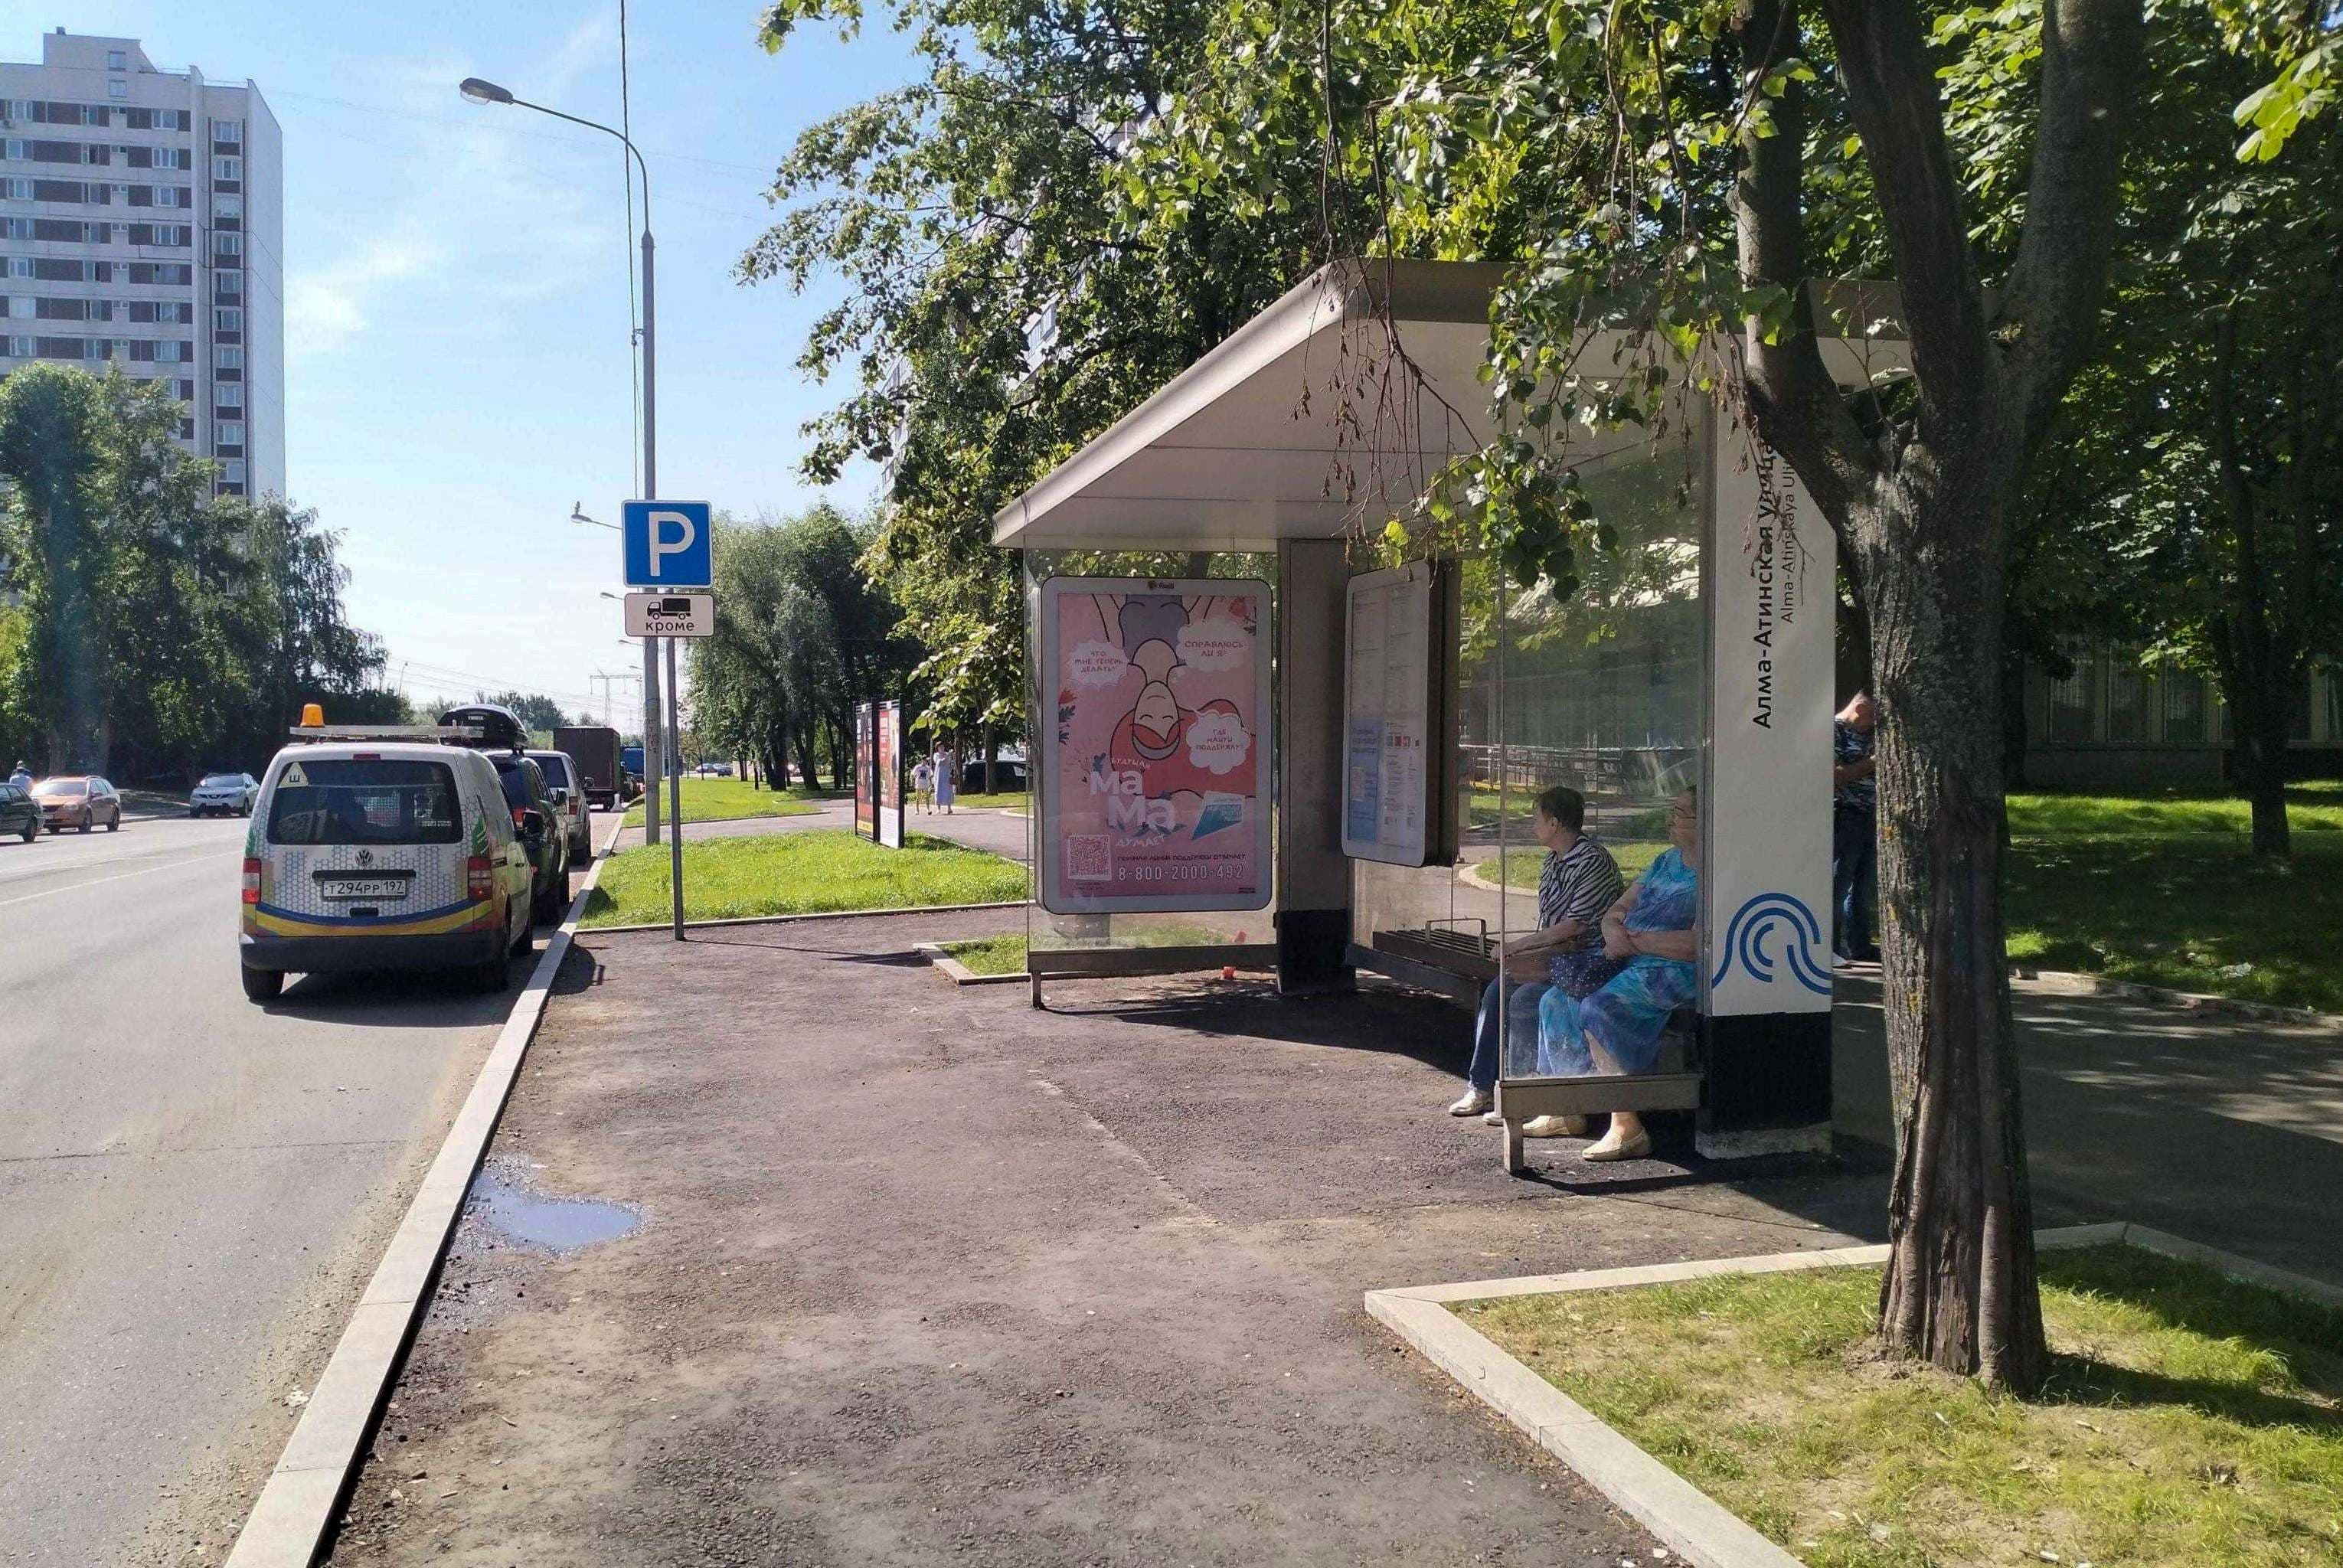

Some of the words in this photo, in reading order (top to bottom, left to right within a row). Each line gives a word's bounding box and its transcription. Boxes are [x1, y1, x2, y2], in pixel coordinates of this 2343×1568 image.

[649, 511, 695, 577] P
[645, 622, 695, 634] кроме
[1753, 527, 1773, 729] Алма-Атинская
[1118, 864, 1243, 880] 8-800-2000-492
[383, 880, 404, 890] 197
